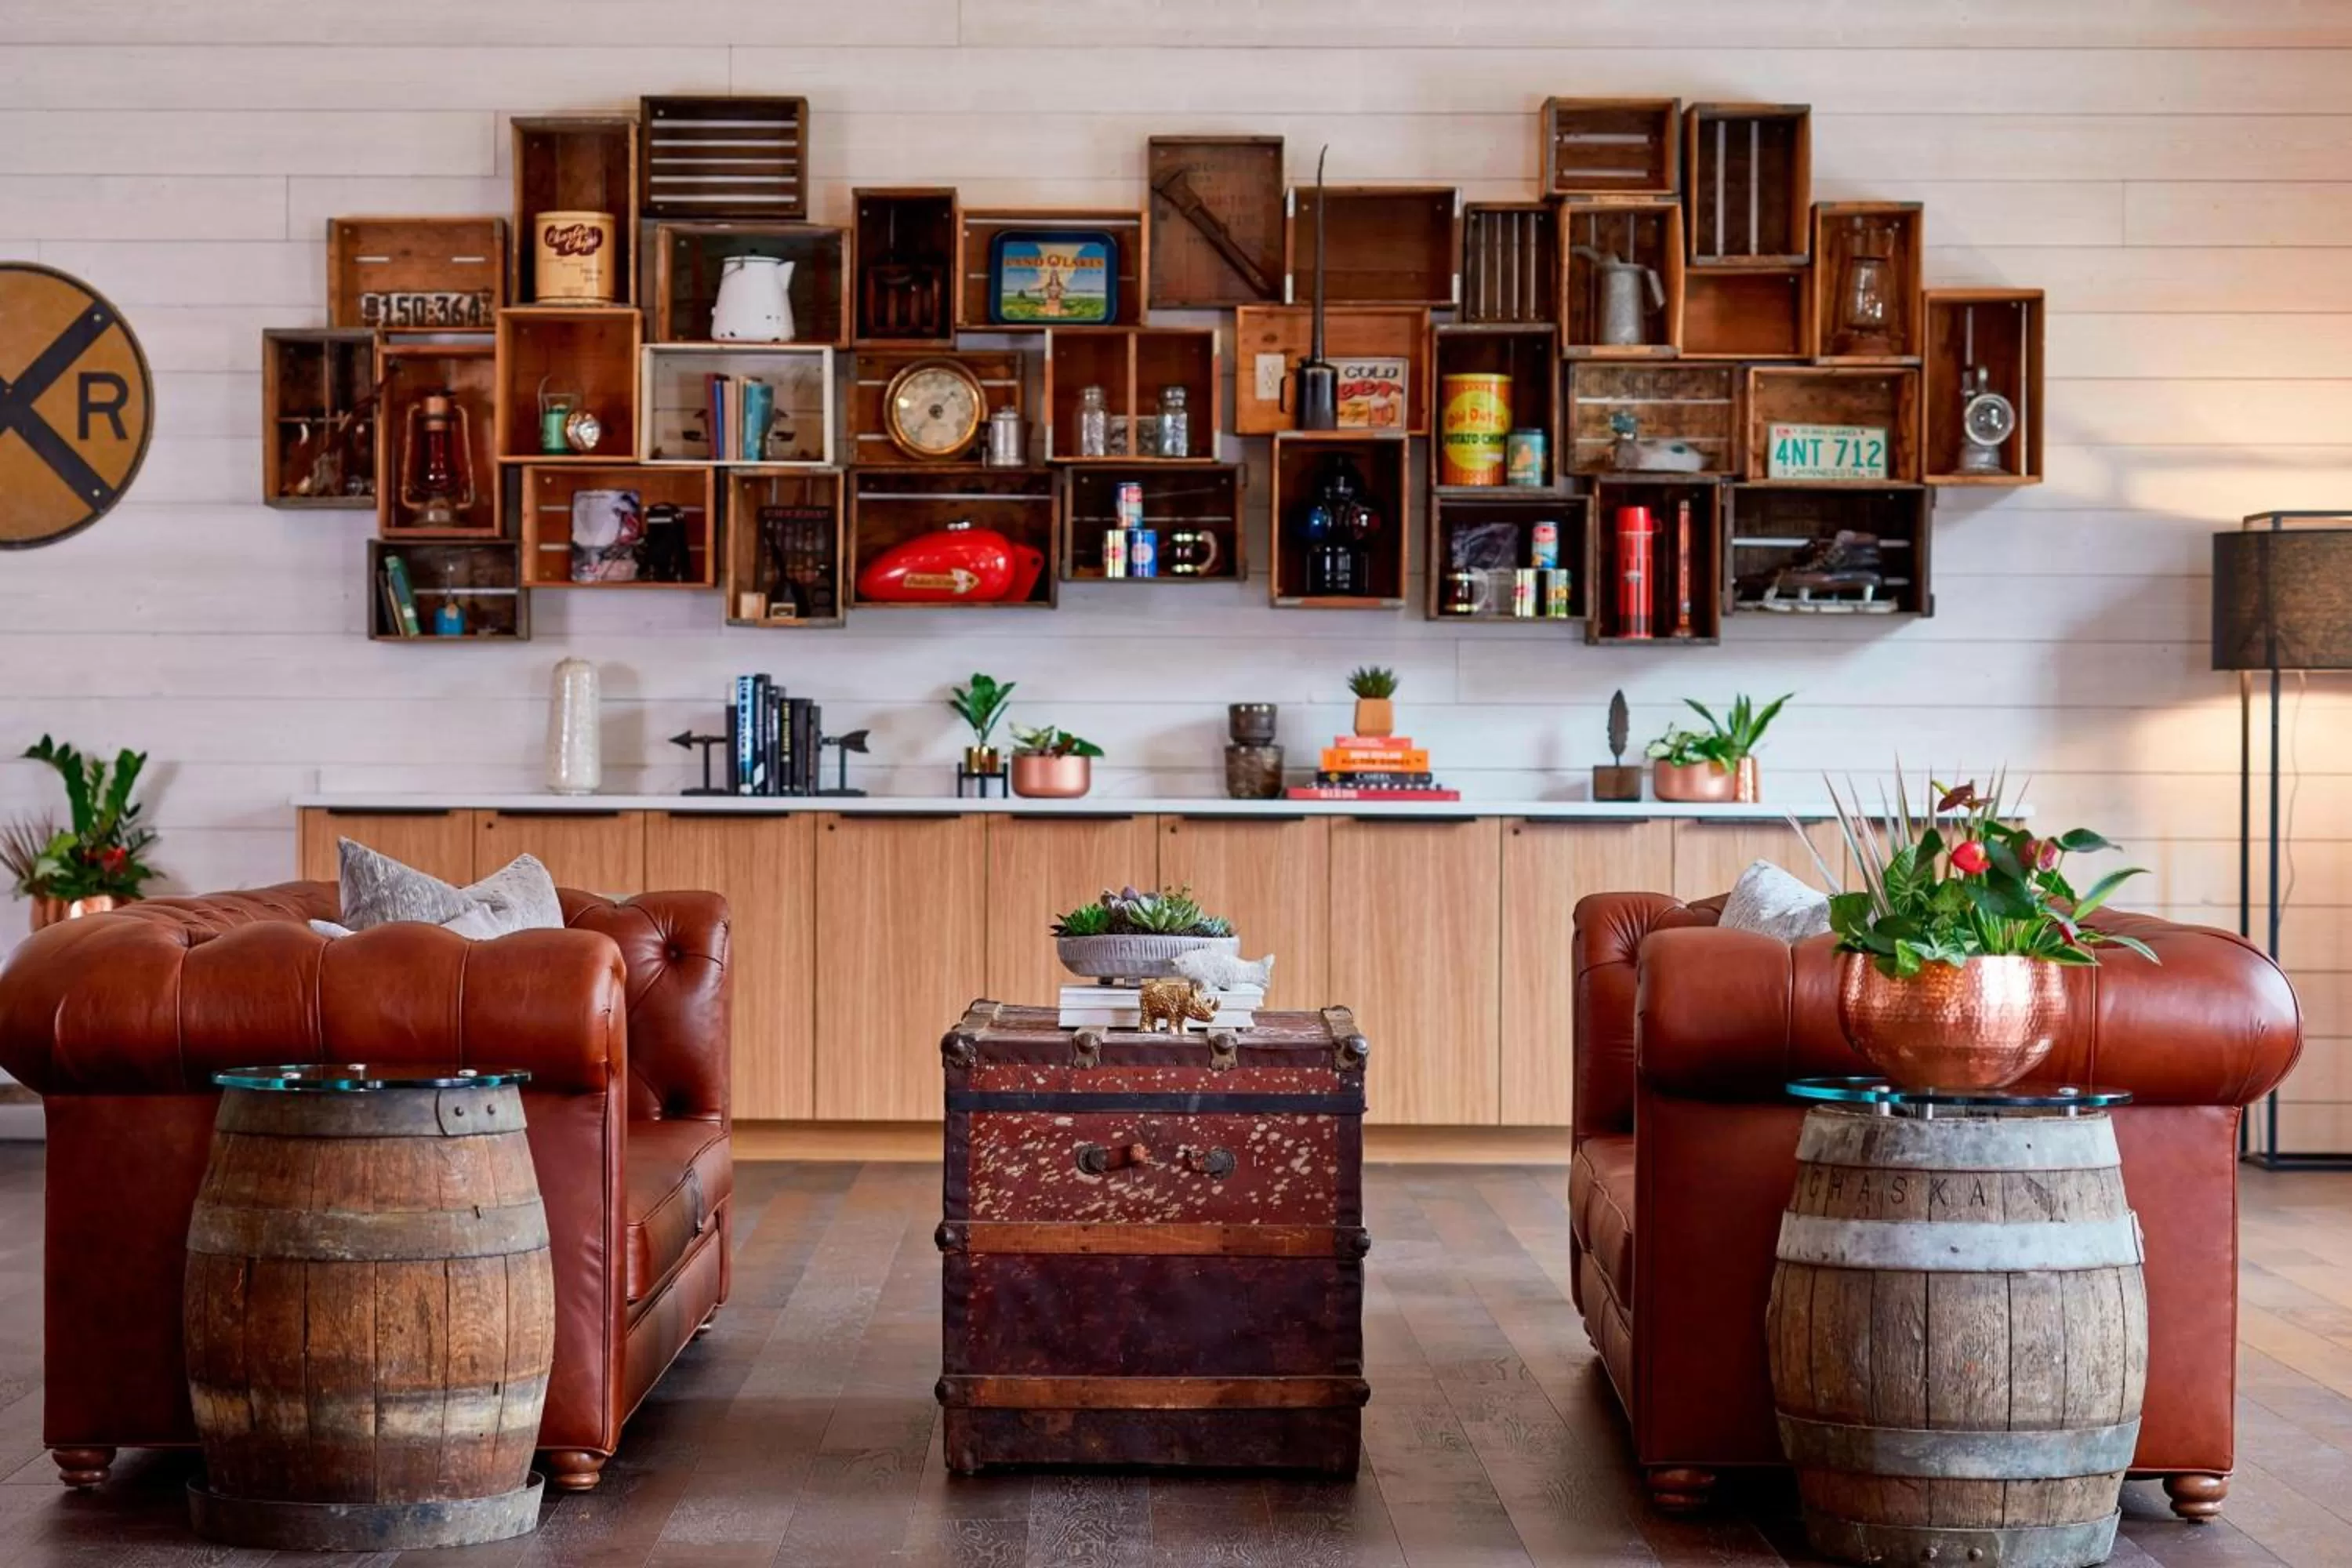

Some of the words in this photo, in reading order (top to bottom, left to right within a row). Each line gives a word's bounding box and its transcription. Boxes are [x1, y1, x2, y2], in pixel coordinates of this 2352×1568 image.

[1344, 365, 1399, 379] COLD
[1337, 380, 1404, 401] eer
[77, 372, 129, 441] R
[1481, 434, 1508, 445] CHIP
[1775, 438, 1823, 466] 4NT
[1834, 438, 1882, 468] 712
[1808, 1165, 1987, 1206] CHASKA
